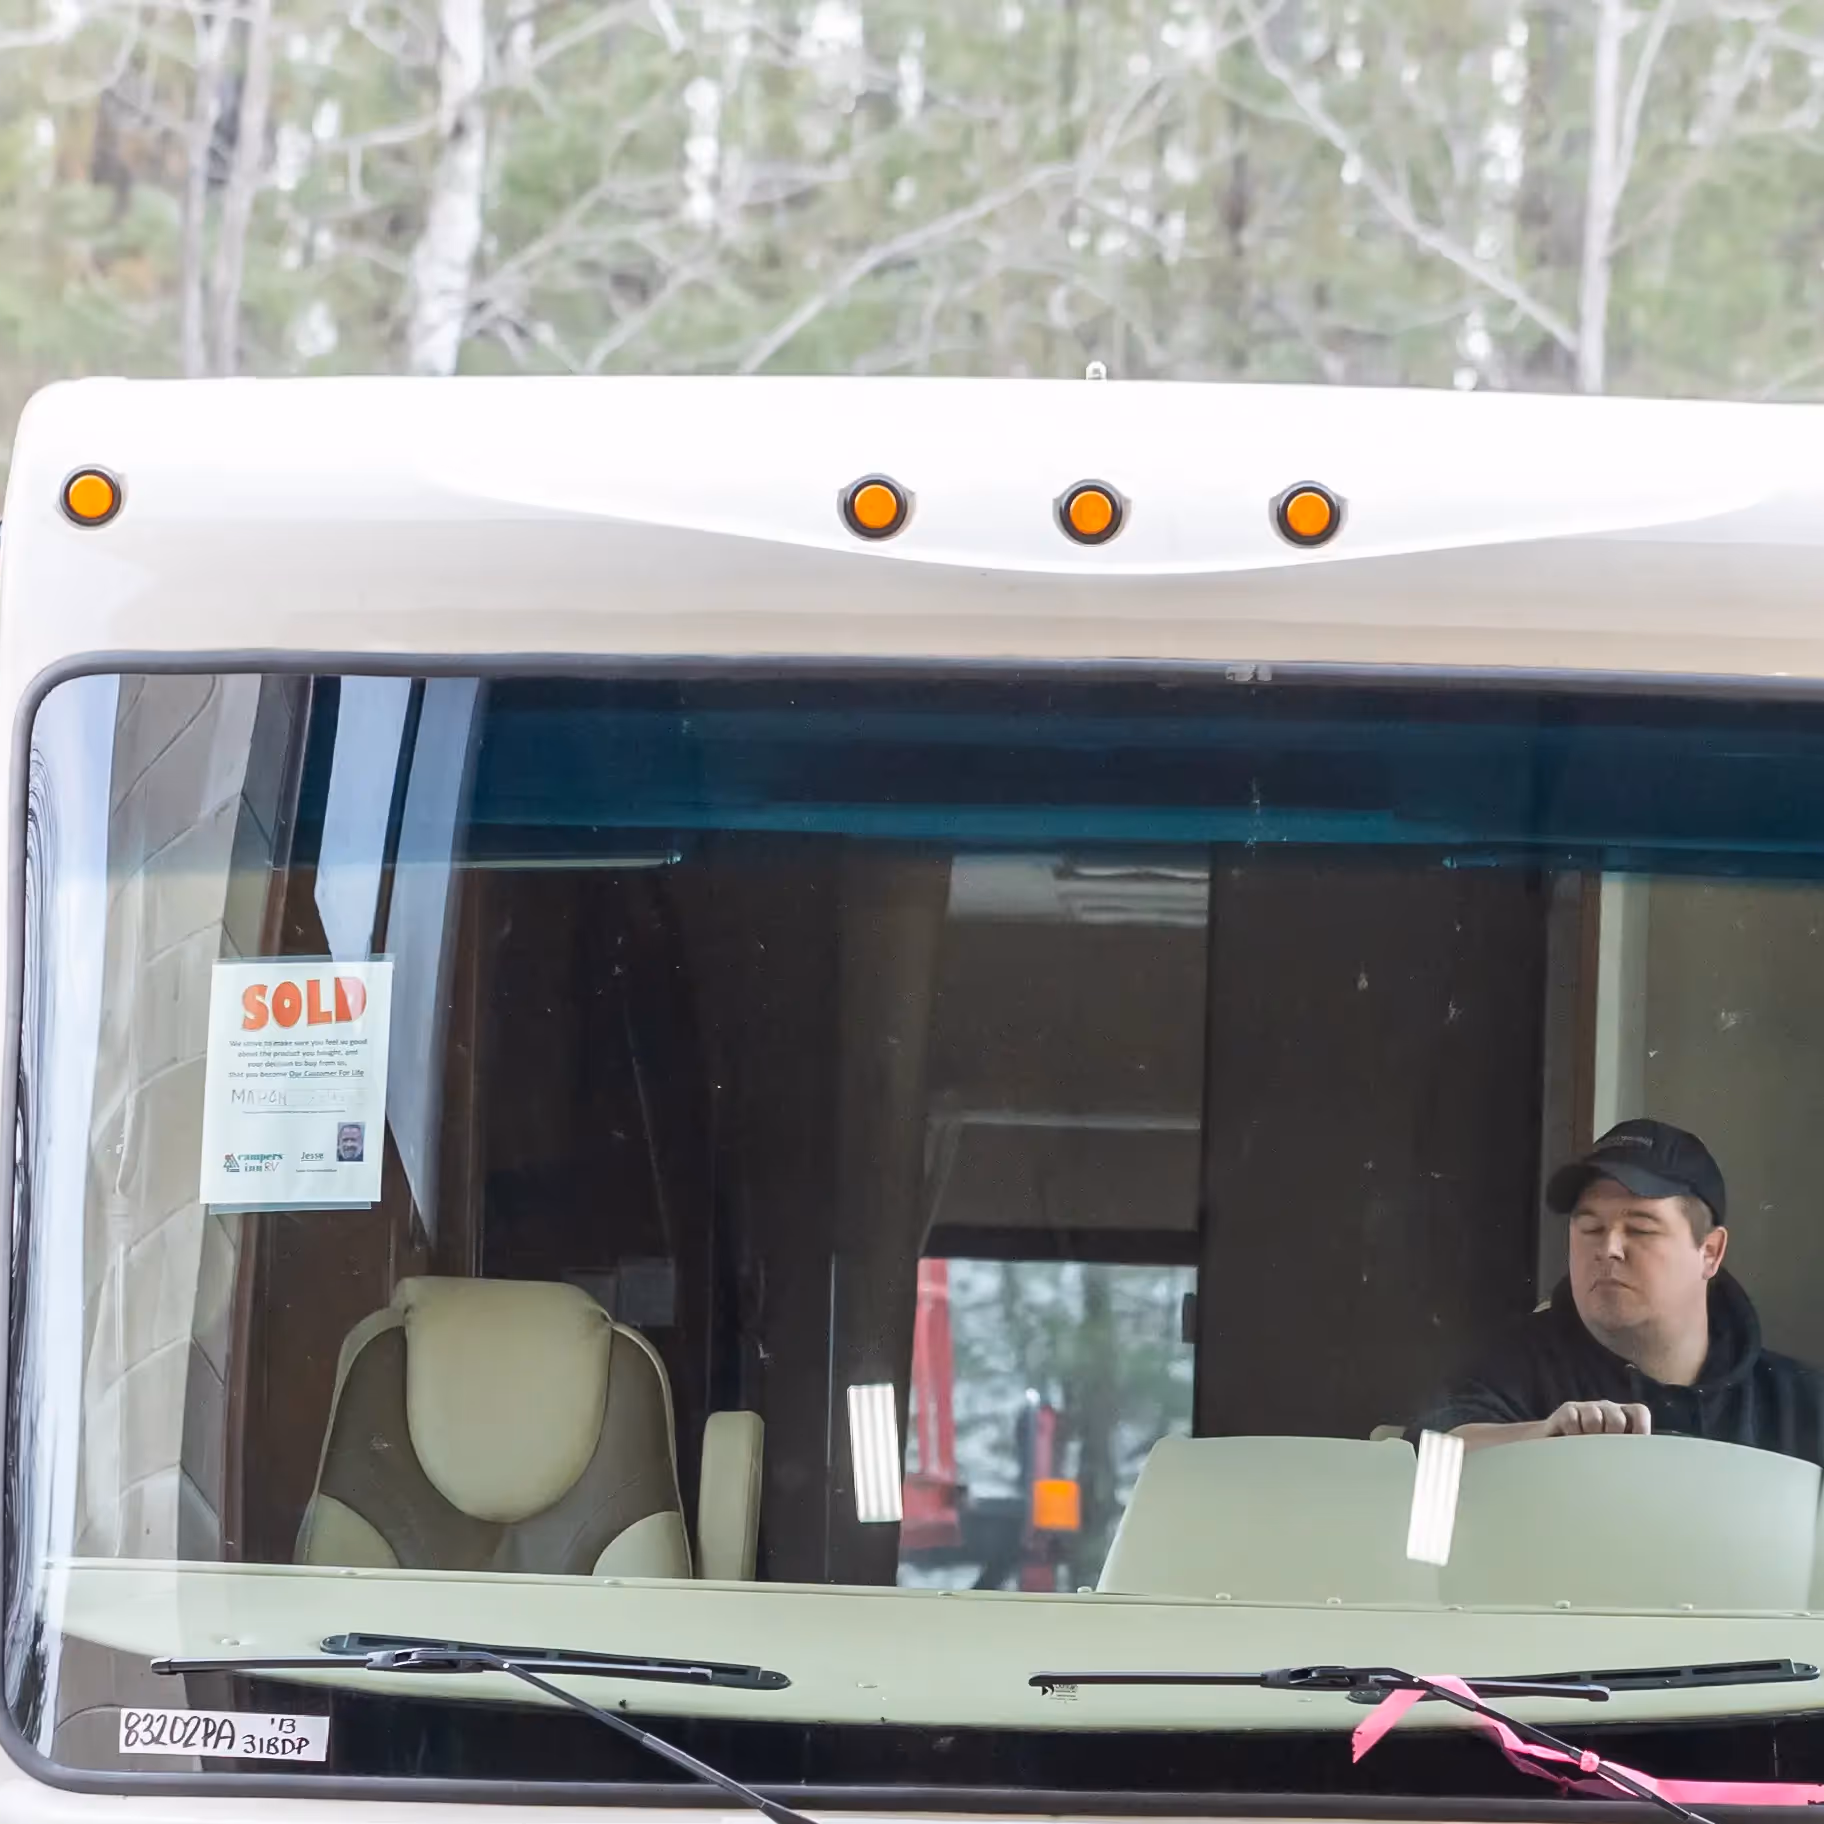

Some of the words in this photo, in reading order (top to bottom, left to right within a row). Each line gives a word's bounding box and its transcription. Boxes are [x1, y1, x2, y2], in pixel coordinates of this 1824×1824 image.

[241, 976, 367, 1032] SOLD
[301, 1151, 325, 1161] Jesse
[125, 1711, 236, 1749] 83202PA
